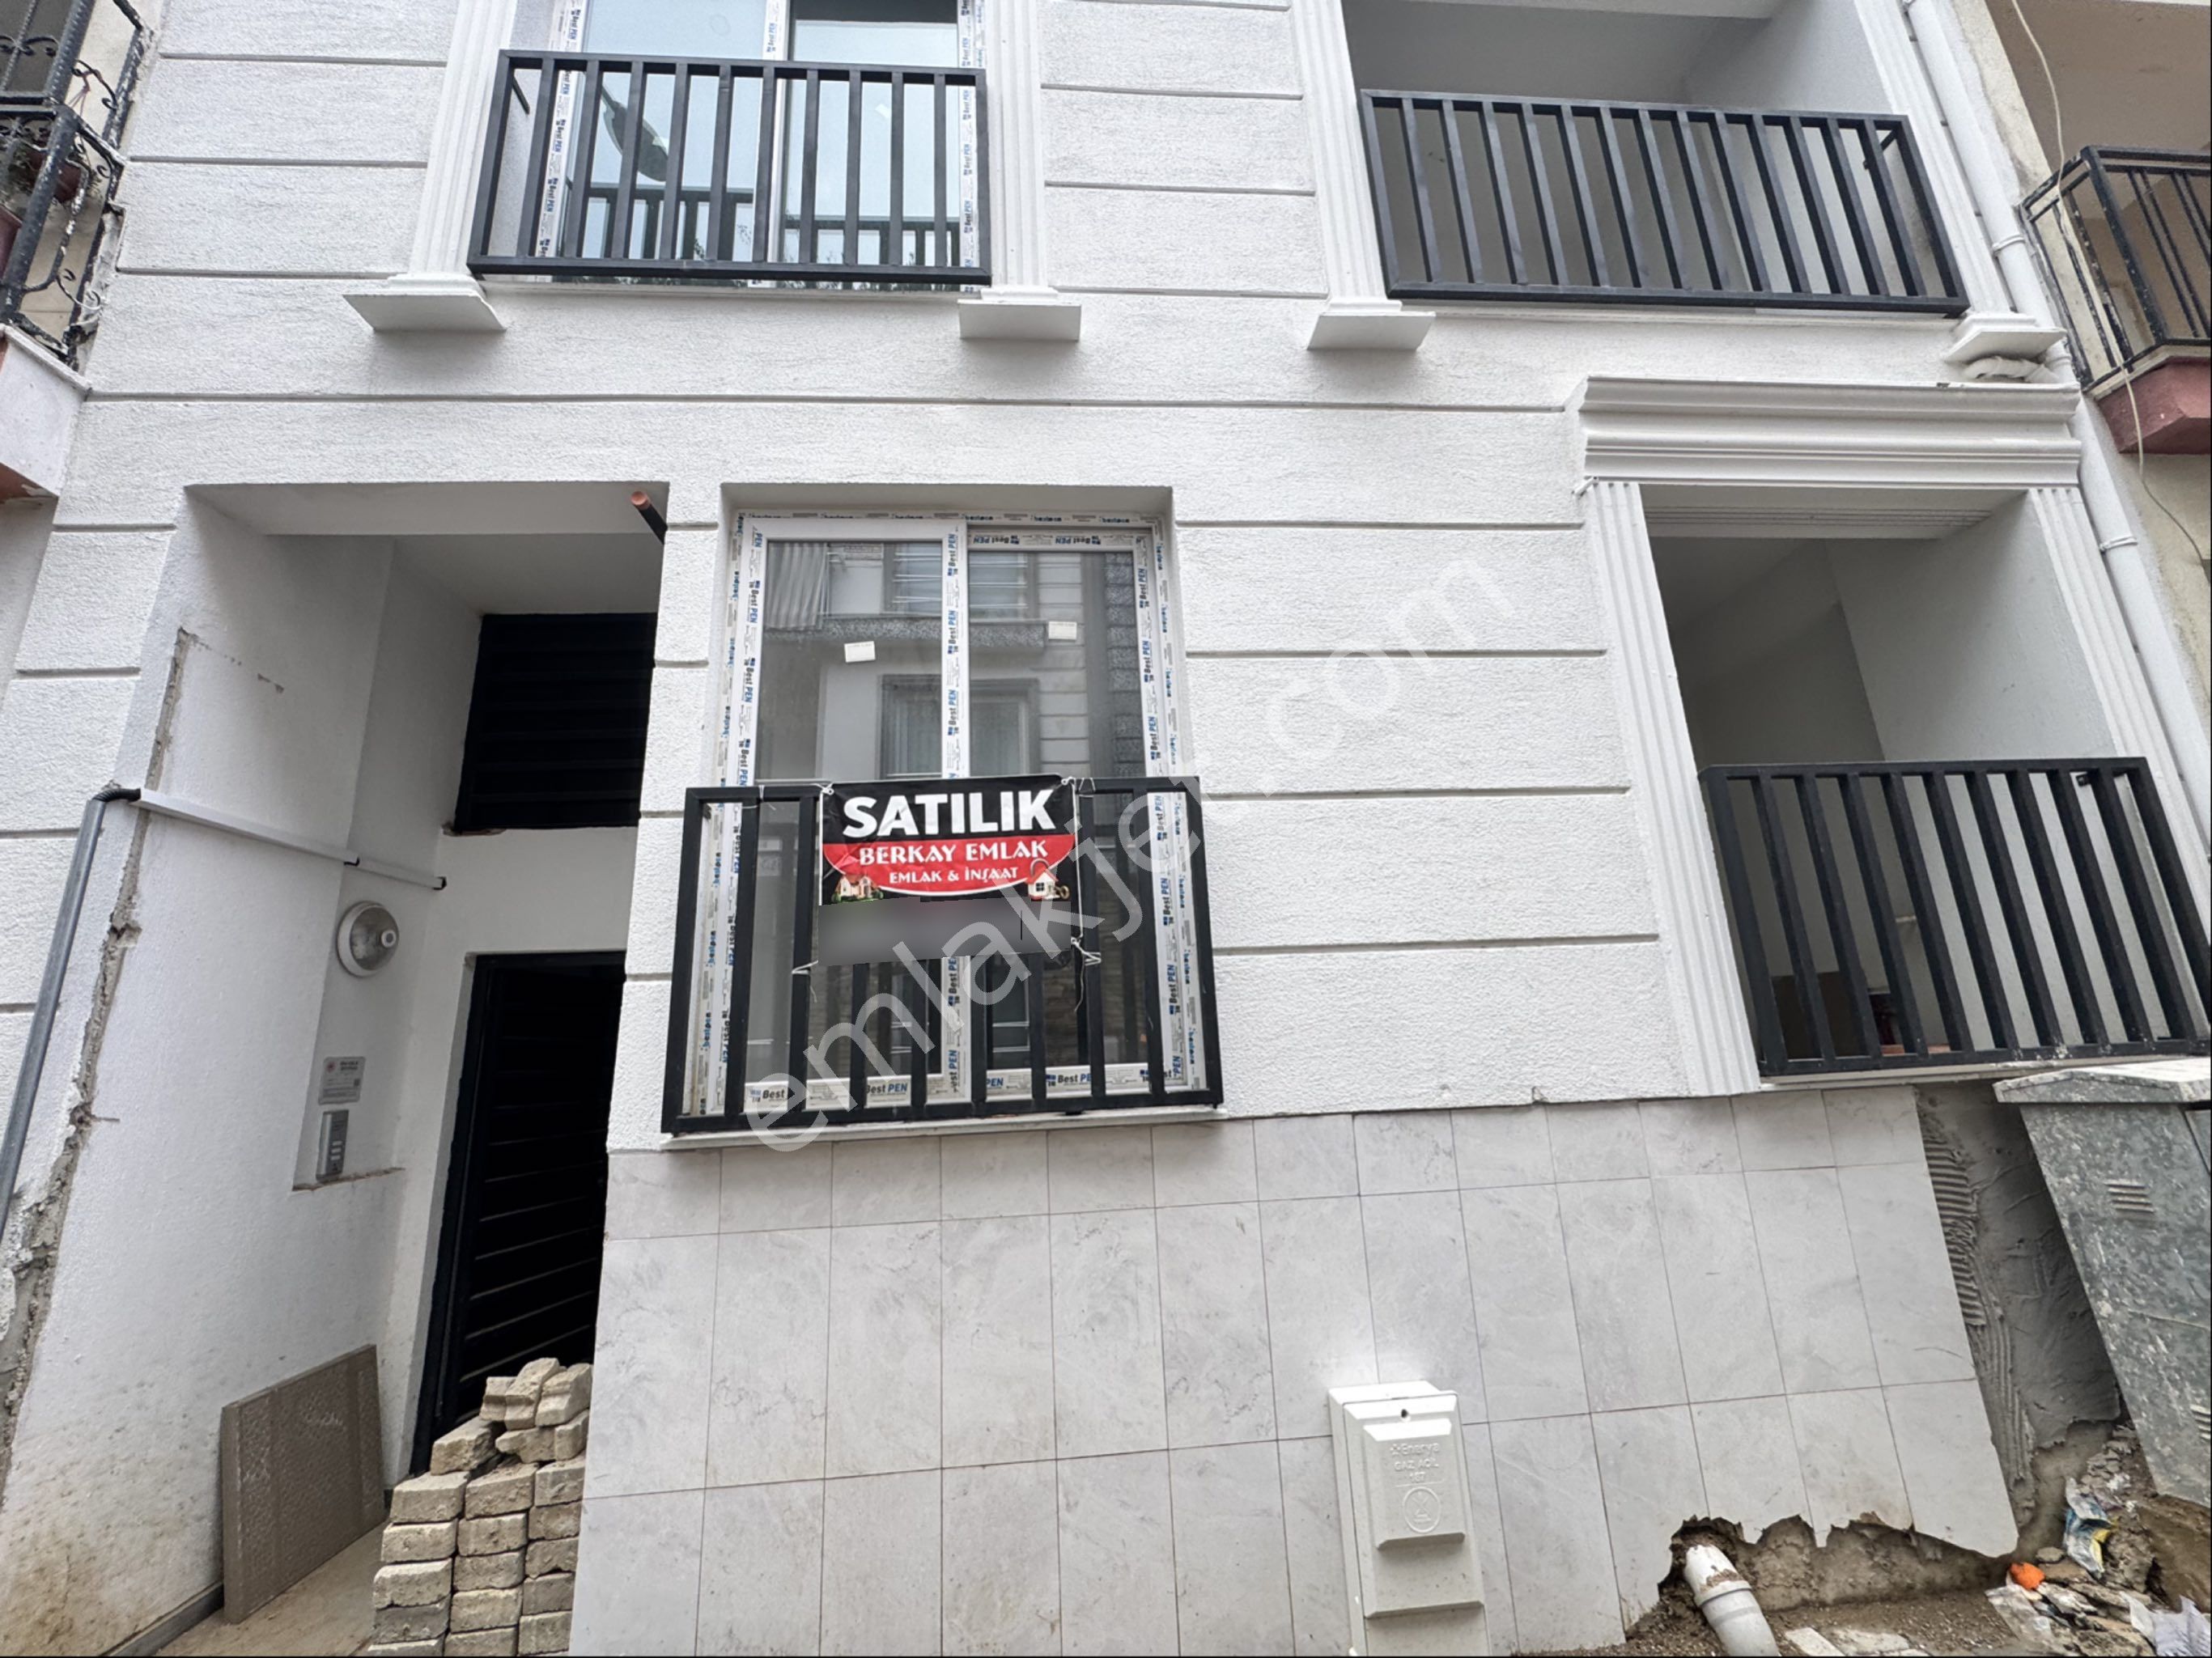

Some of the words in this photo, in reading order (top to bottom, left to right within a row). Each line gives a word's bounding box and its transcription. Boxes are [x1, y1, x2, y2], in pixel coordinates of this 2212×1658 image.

[843, 790, 1056, 838] SATILIK
[860, 844, 957, 866] BERKAY
[966, 840, 1048, 861] EMLAK
[889, 870, 942, 884] EMLAK
[948, 869, 960, 882] &
[965, 867, 1018, 884] İNŞAAT
[949, 958, 957, 971] PE
[1167, 965, 1176, 982] PEN
[1169, 985, 1178, 1003] Best
[1058, 1075, 1078, 1083] Best
[1081, 1074, 1092, 1082] PE
[762, 1088, 785, 1099] Best
[888, 1083, 907, 1092] PEN
